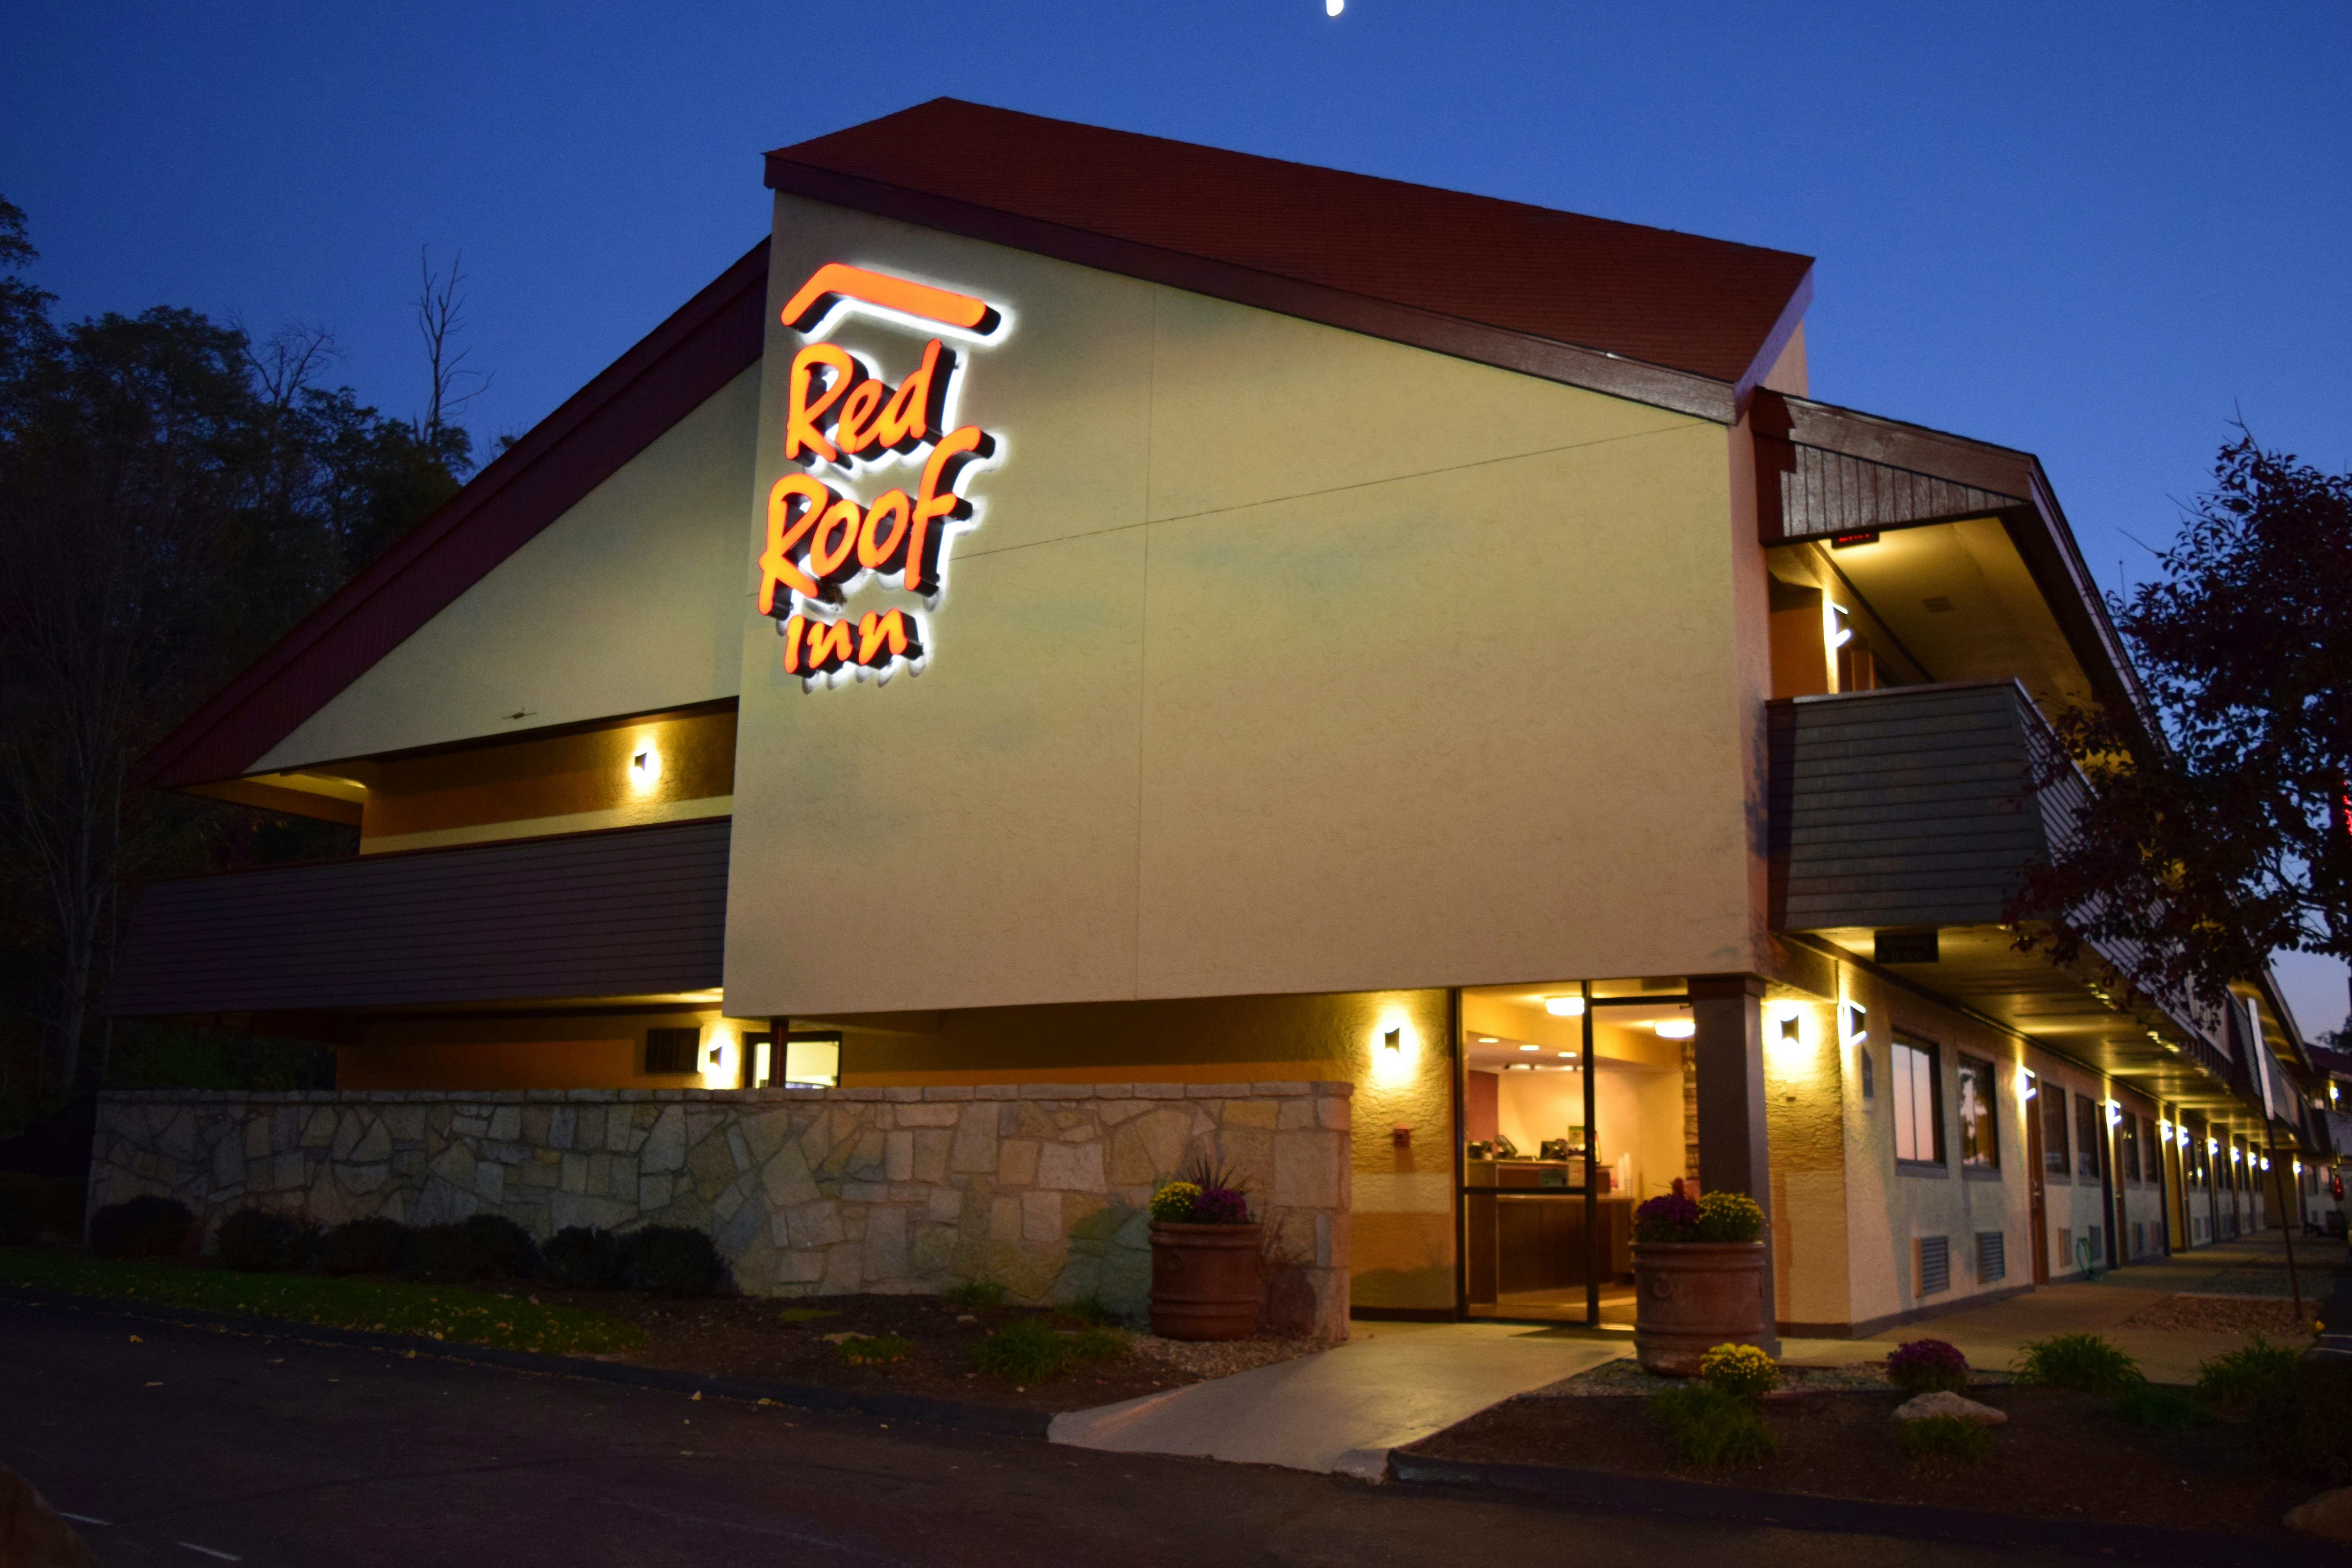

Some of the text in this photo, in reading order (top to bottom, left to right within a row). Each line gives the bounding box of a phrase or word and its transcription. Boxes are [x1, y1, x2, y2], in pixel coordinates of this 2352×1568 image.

[785, 338, 942, 462] Red
[758, 425, 981, 615] Roof
[784, 608, 908, 674] Inn
